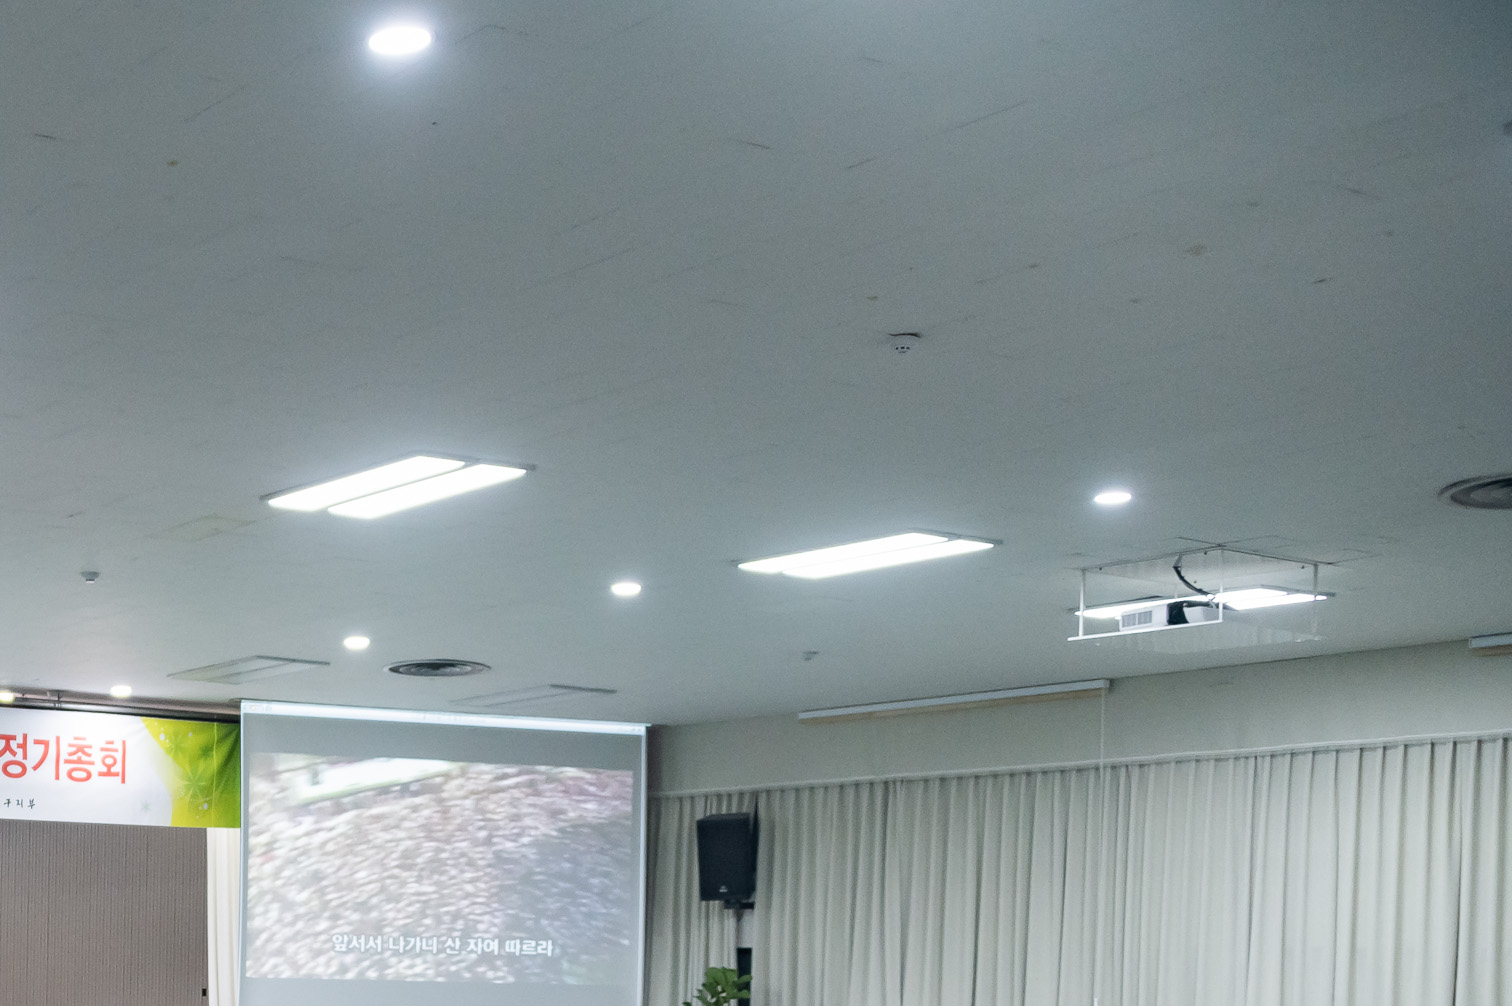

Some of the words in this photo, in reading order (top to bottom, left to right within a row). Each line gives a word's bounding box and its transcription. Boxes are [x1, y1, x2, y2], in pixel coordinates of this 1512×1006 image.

[331, 934, 382, 952] 앞서서
[388, 936, 438, 954] 나가니
[444, 937, 461, 955] 산
[466, 938, 499, 956] 자여
[505, 939, 554, 957] 따르라
